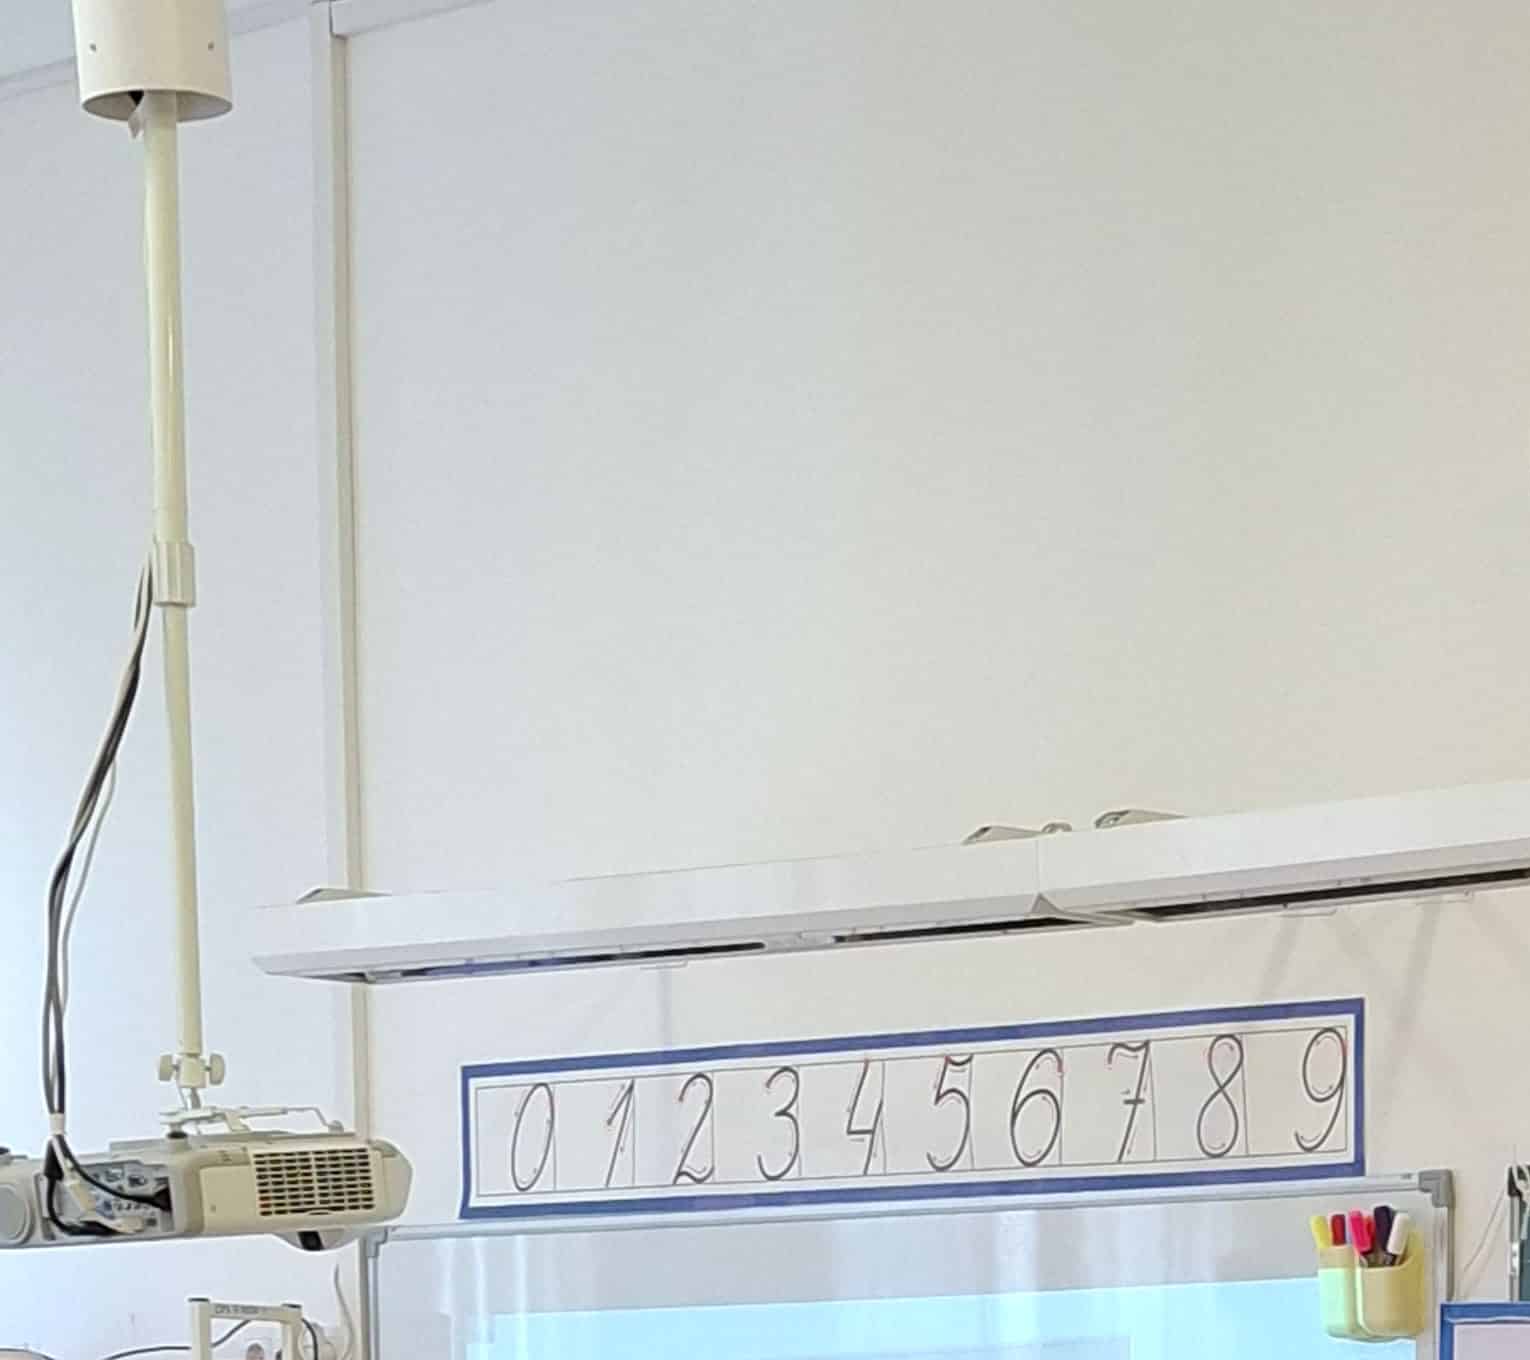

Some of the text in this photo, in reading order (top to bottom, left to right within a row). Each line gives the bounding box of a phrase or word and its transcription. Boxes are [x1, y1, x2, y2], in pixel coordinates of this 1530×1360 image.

[512, 1027, 1345, 1192] 0 1 2 3 4 5 6 7 8 9
